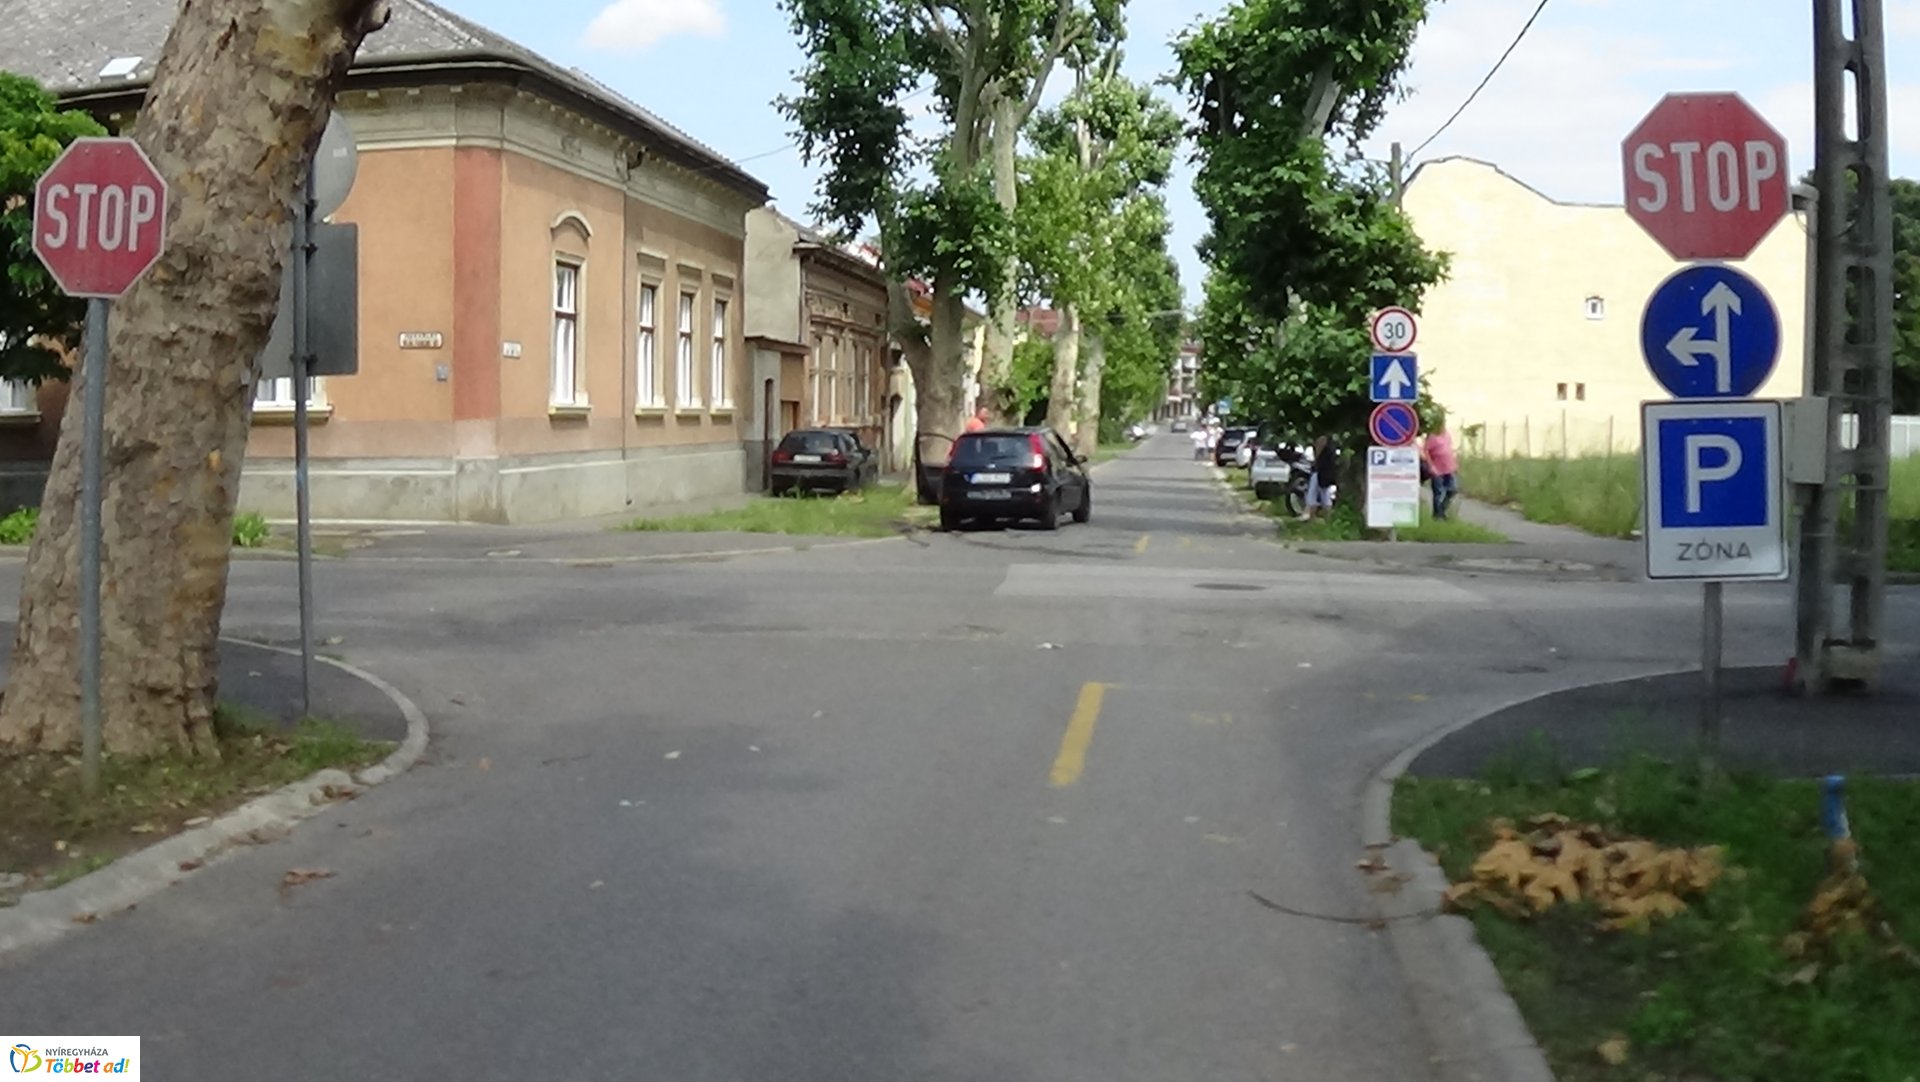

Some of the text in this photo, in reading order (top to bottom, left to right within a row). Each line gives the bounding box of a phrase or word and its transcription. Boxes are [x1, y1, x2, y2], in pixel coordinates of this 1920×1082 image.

[1634, 140, 1777, 213] STOP
[44, 183, 156, 252] STOP
[1384, 322, 1405, 339] 30
[1374, 451, 1385, 464] P
[1685, 434, 1743, 513] P
[1676, 539, 1752, 561] ZÓNA
